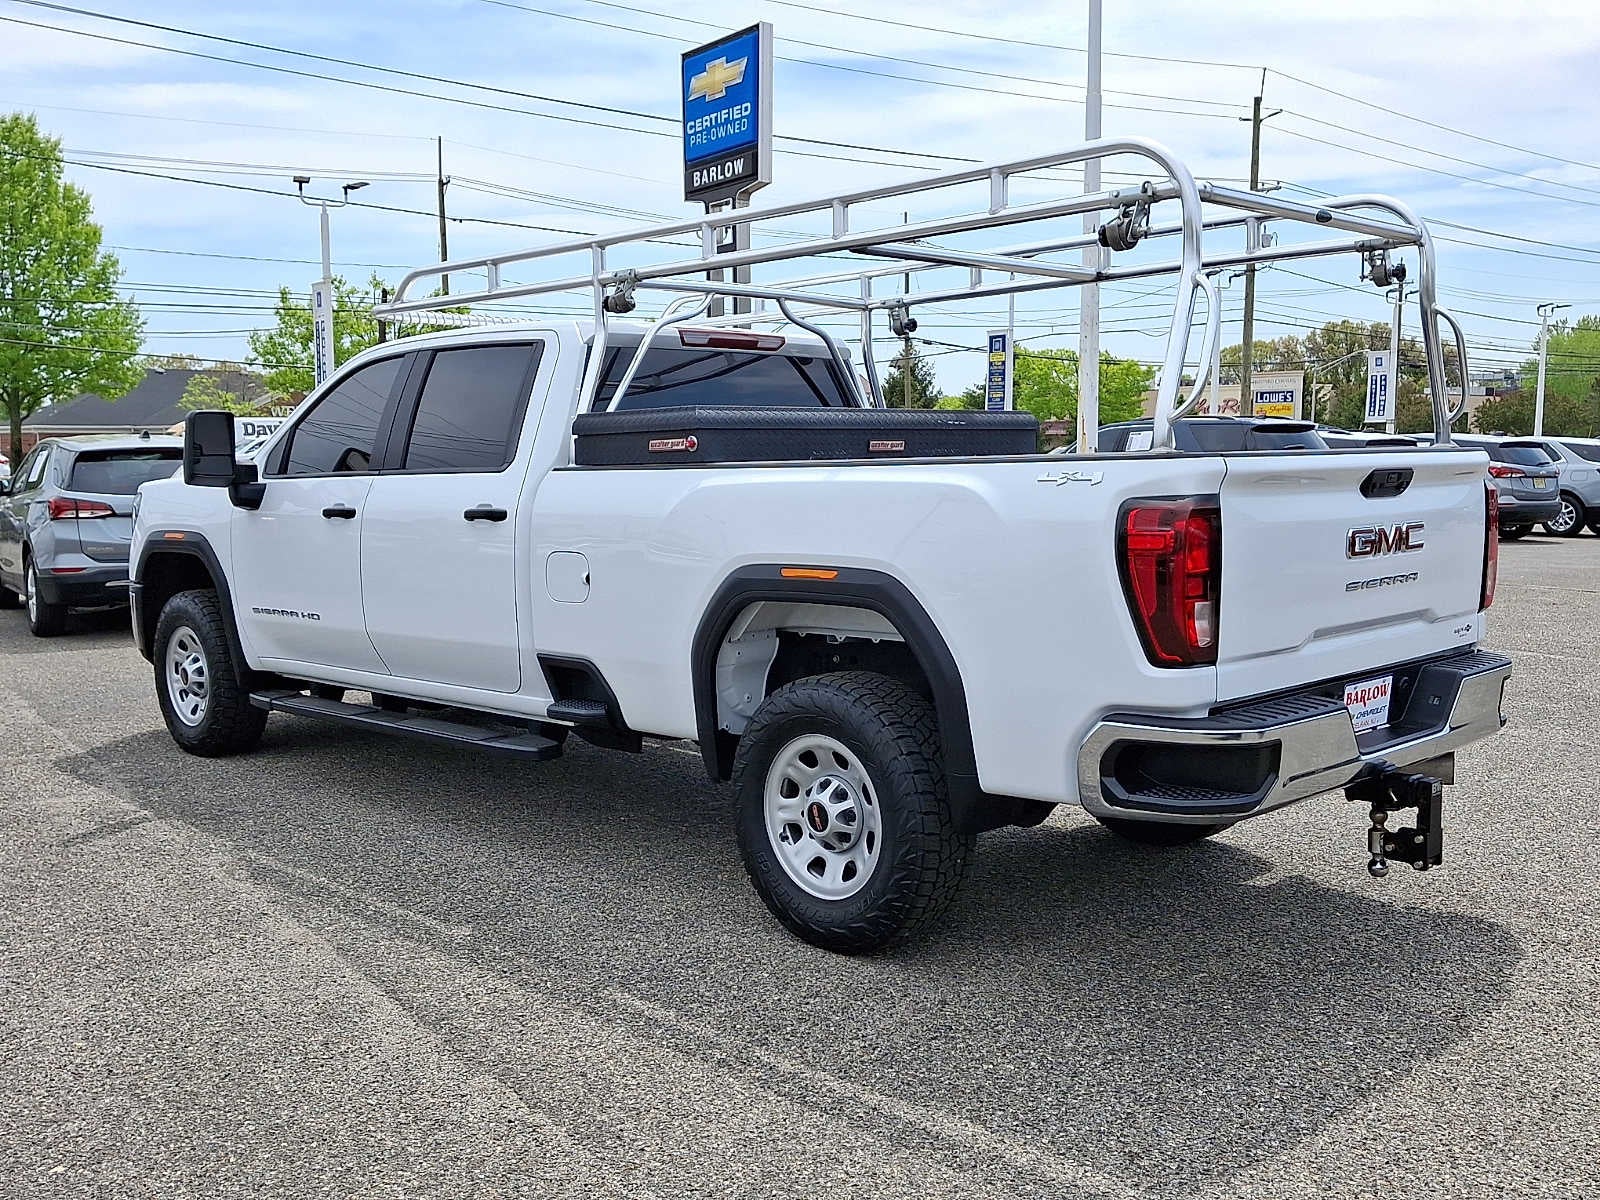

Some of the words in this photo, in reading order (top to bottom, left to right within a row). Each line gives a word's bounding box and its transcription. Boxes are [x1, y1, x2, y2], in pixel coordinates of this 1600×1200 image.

[687, 102, 751, 135] CERTIFIED
[690, 119, 748, 147] PRE-OWNED
[693, 158, 744, 187] BARLOW
[1256, 391, 1293, 403] LOWE'S
[242, 421, 282, 438] Dav
[1345, 520, 1425, 560] GMC
[1345, 572, 1419, 592] SIERRA
[252, 607, 299, 618] SIERRA
[301, 611, 321, 621] HD
[1346, 683, 1390, 707] BARLOW
